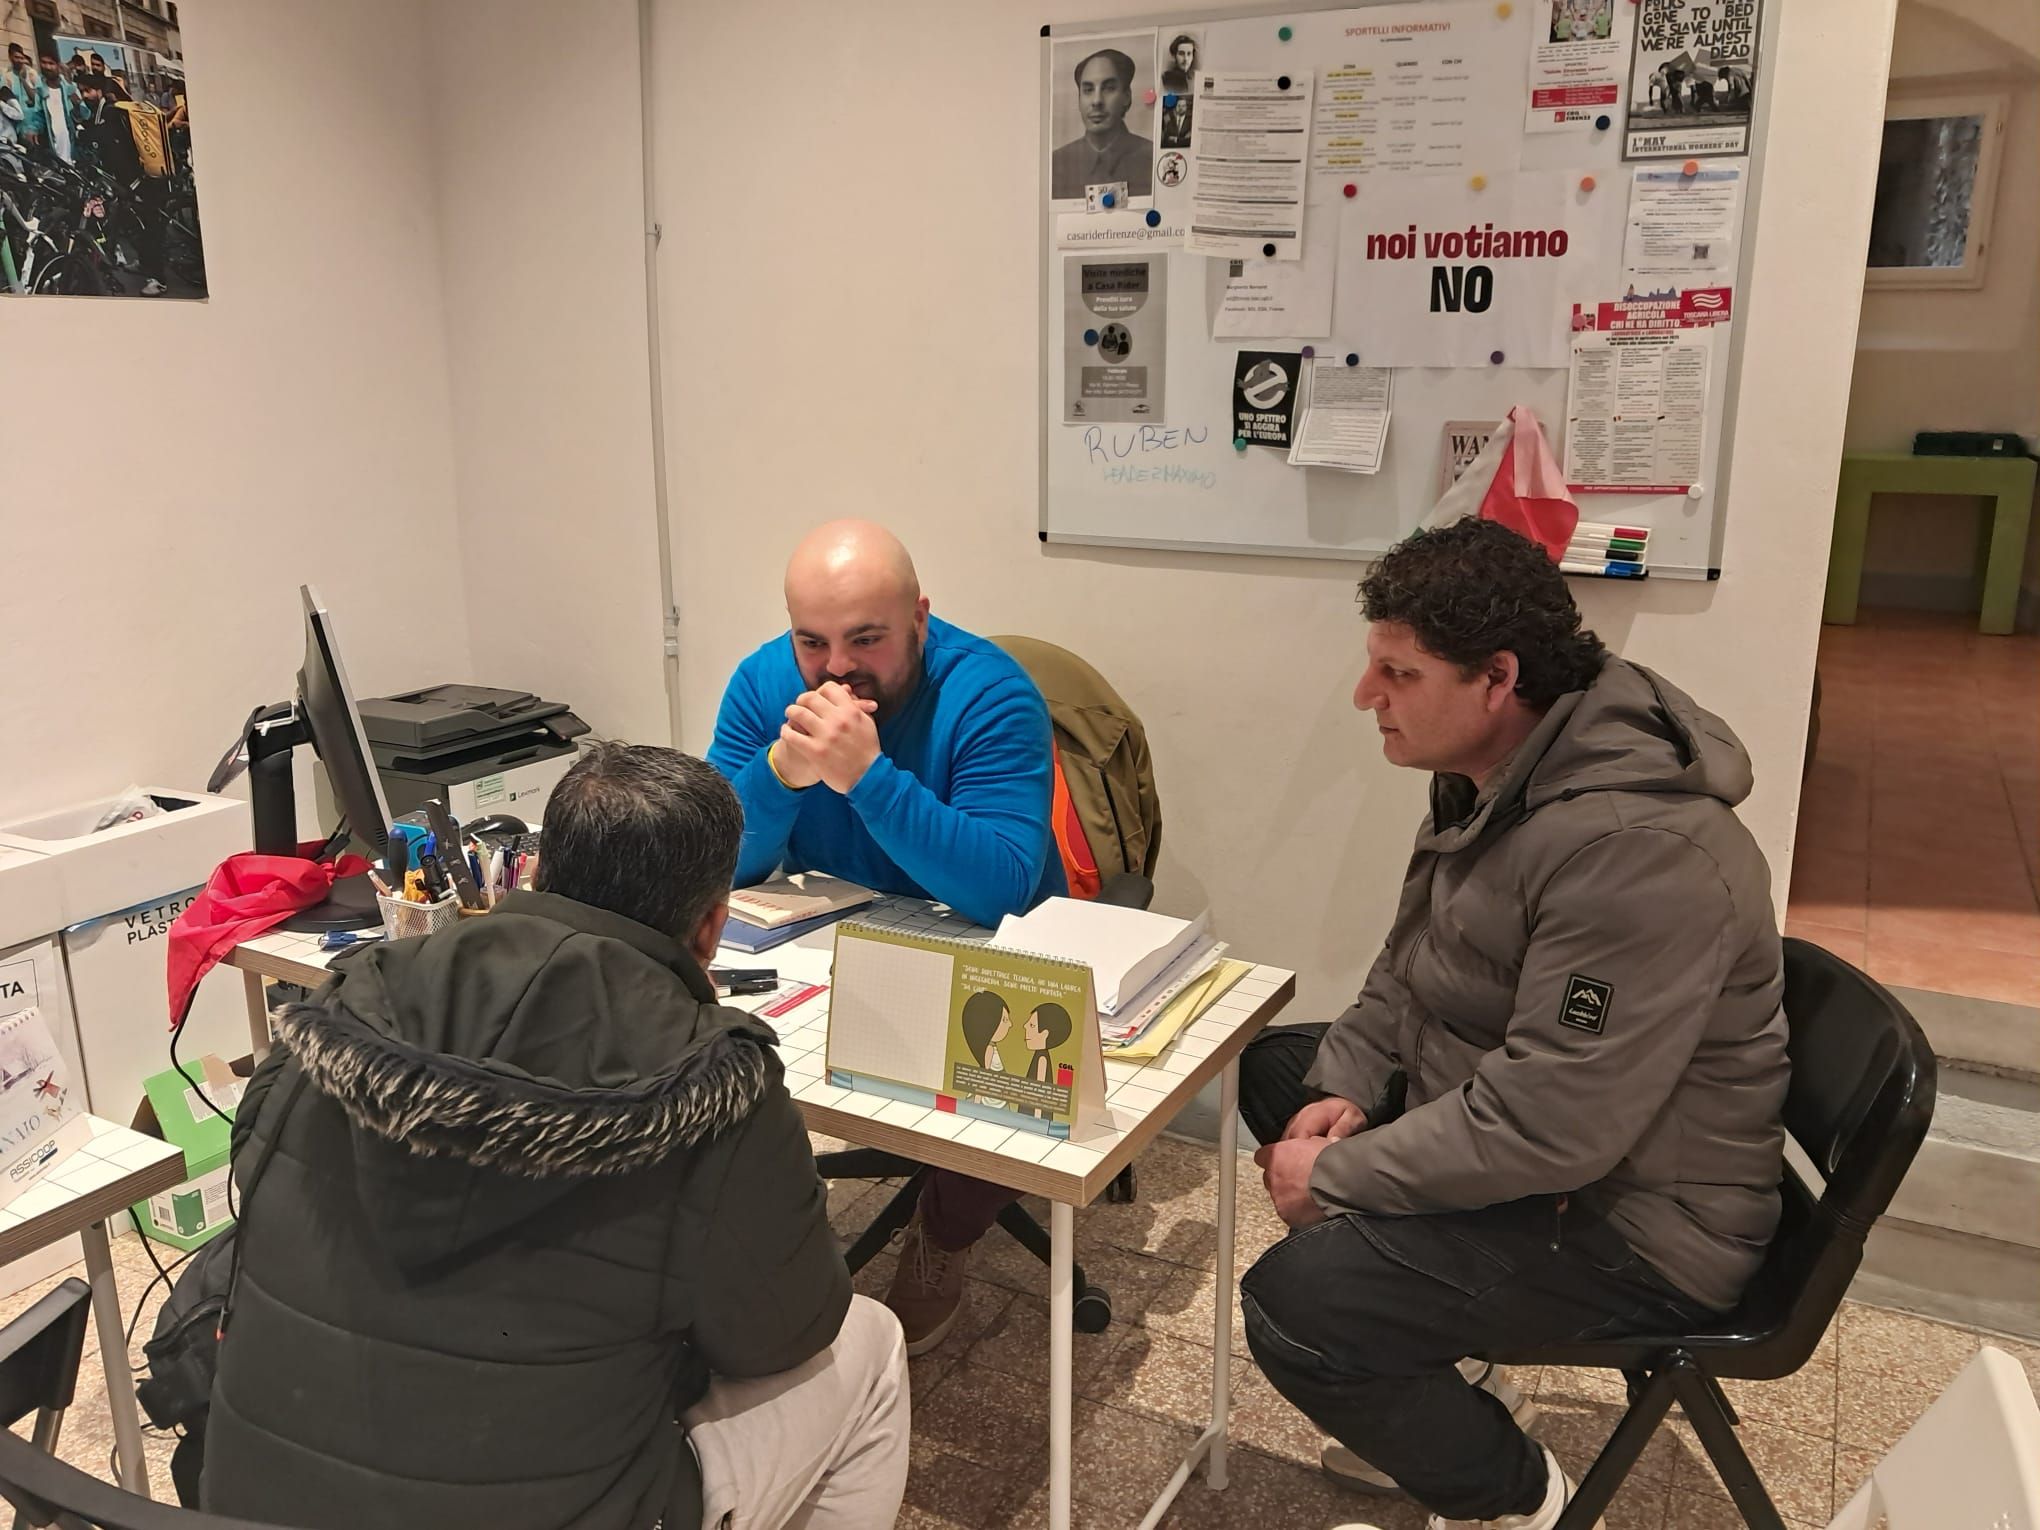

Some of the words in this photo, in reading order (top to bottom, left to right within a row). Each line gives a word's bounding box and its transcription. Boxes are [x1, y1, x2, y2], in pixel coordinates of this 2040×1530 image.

[1645, 0, 1686, 11] FOLKS
[1643, 10, 1678, 25] GONE
[1691, 7, 1711, 21] TO
[1725, 3, 1754, 18] BED
[1344, 25, 1391, 37] SPORTELLI
[1391, 21, 1451, 34] INFORMATIVI
[1642, 25, 1666, 38] WE
[1669, 21, 1708, 36] SLAVE
[1711, 17, 1753, 32] UNTIL
[1641, 36, 1685, 51] WE'RE
[1693, 31, 1752, 47] ALMOST
[1710, 44, 1750, 59] DEAD
[1725, 140, 1740, 149] DAY
[1366, 224, 1417, 260] noi
[1424, 222, 1569, 259] votiamo
[1430, 265, 1494, 313] NO
[1614, 300, 1681, 312] DISOCCUPAZIONE
[1626, 310, 1666, 320] AGRICOLA
[1610, 320, 1625, 330] CHI
[1238, 411, 1255, 422] UNO
[1255, 412, 1287, 424] SPETTRO
[1244, 421, 1251, 429] SI
[1252, 421, 1280, 432] AGGIRA
[1238, 429, 1252, 438] PER
[1252, 430, 1288, 441] L'EUROPA
[1084, 424, 1208, 464] RUBEN
[127, 916, 179, 945] PLAST
[1058, 1062, 1075, 1071] CGIL
[10, 1139, 56, 1179] ASSICOOP
